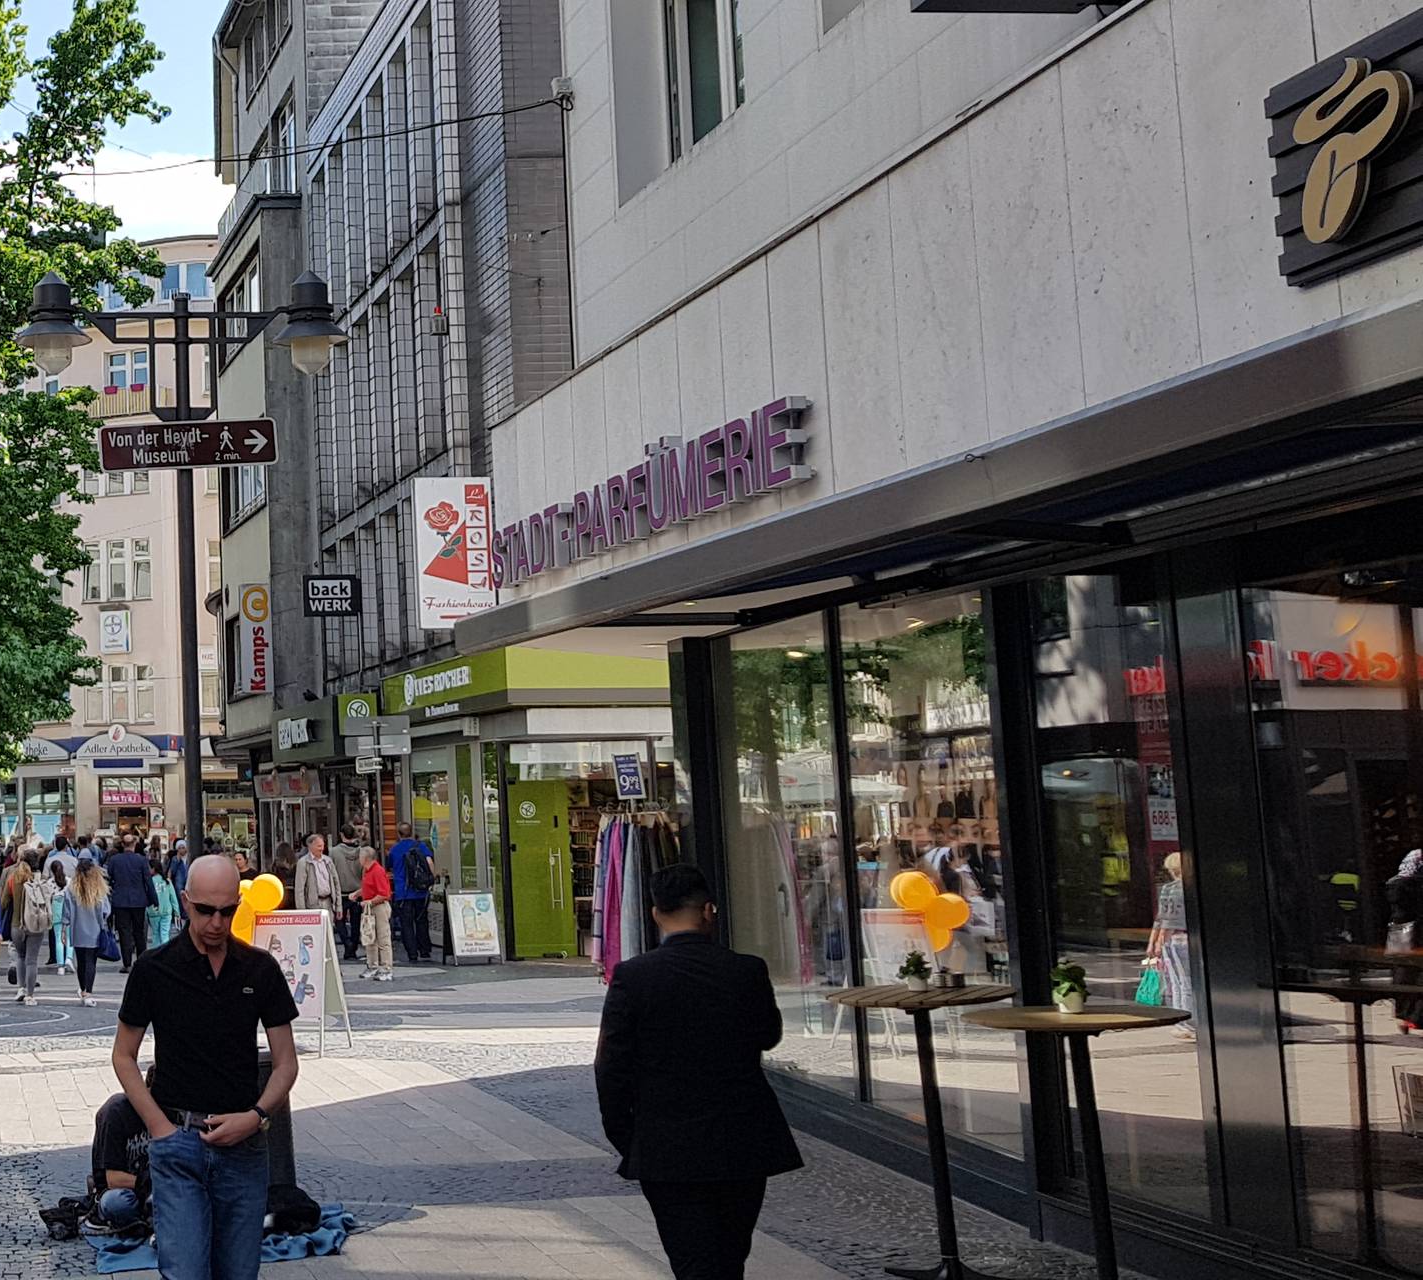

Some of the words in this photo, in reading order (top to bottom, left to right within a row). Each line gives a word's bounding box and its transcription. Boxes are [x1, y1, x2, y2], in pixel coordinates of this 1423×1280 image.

[108, 431, 133, 448] Von
[137, 429, 159, 447] der
[163, 427, 209, 449] Heydt-
[132, 449, 189, 465] Museum
[215, 452, 221, 461] 2
[223, 450, 242, 460] min.
[311, 582, 349, 597] back
[309, 599, 352, 612] WERK
[423, 596, 494, 610] Fashionhouse
[250, 626, 269, 691] Kamps
[85, 745, 108, 754] Adler
[111, 743, 151, 757] Apotheke
[259, 916, 293, 924] ANGEBOTE
